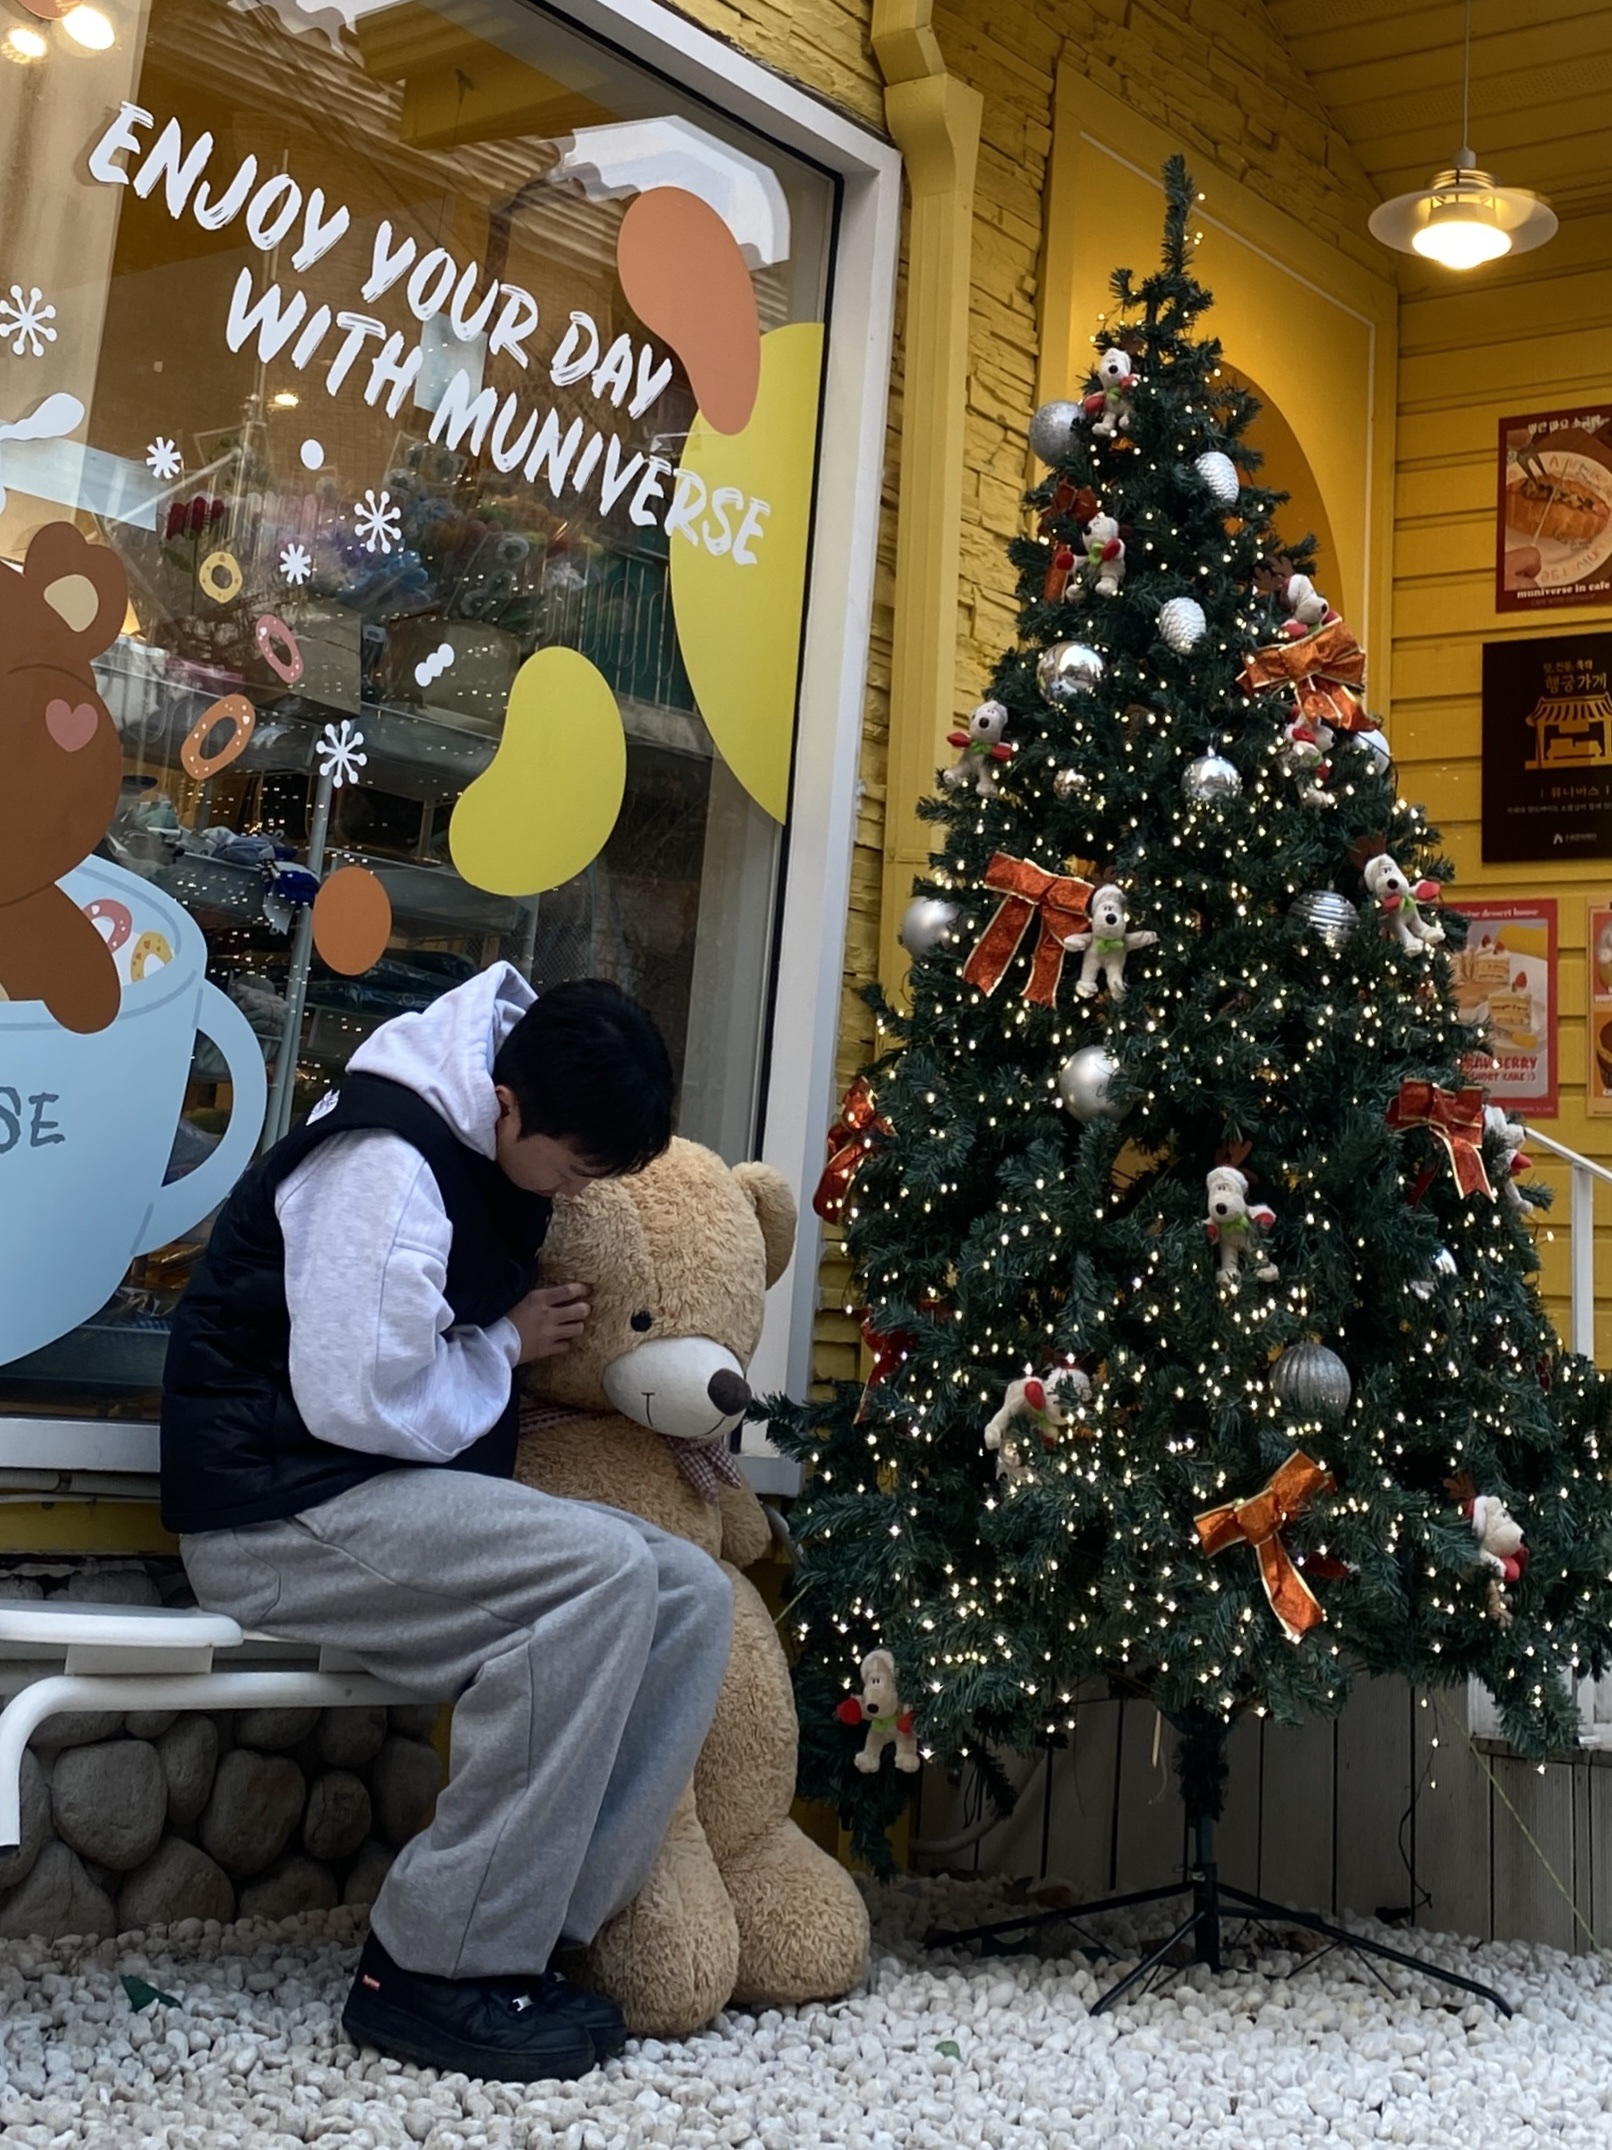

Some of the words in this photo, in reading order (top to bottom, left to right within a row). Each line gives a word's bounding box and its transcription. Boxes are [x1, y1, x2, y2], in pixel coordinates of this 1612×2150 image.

[88, 100, 350, 273] ENJOY
[361, 220, 538, 370] YOUR
[550, 311, 673, 420] DAY
[226, 266, 423, 420] WITH
[428, 368, 772, 566] MUNIVERSE
[1517, 586, 1573, 599] muniverse
[1575, 583, 1586, 593] in
[1588, 580, 1610, 590] cafe
[1545, 671, 1607, 694] 행궁가게
